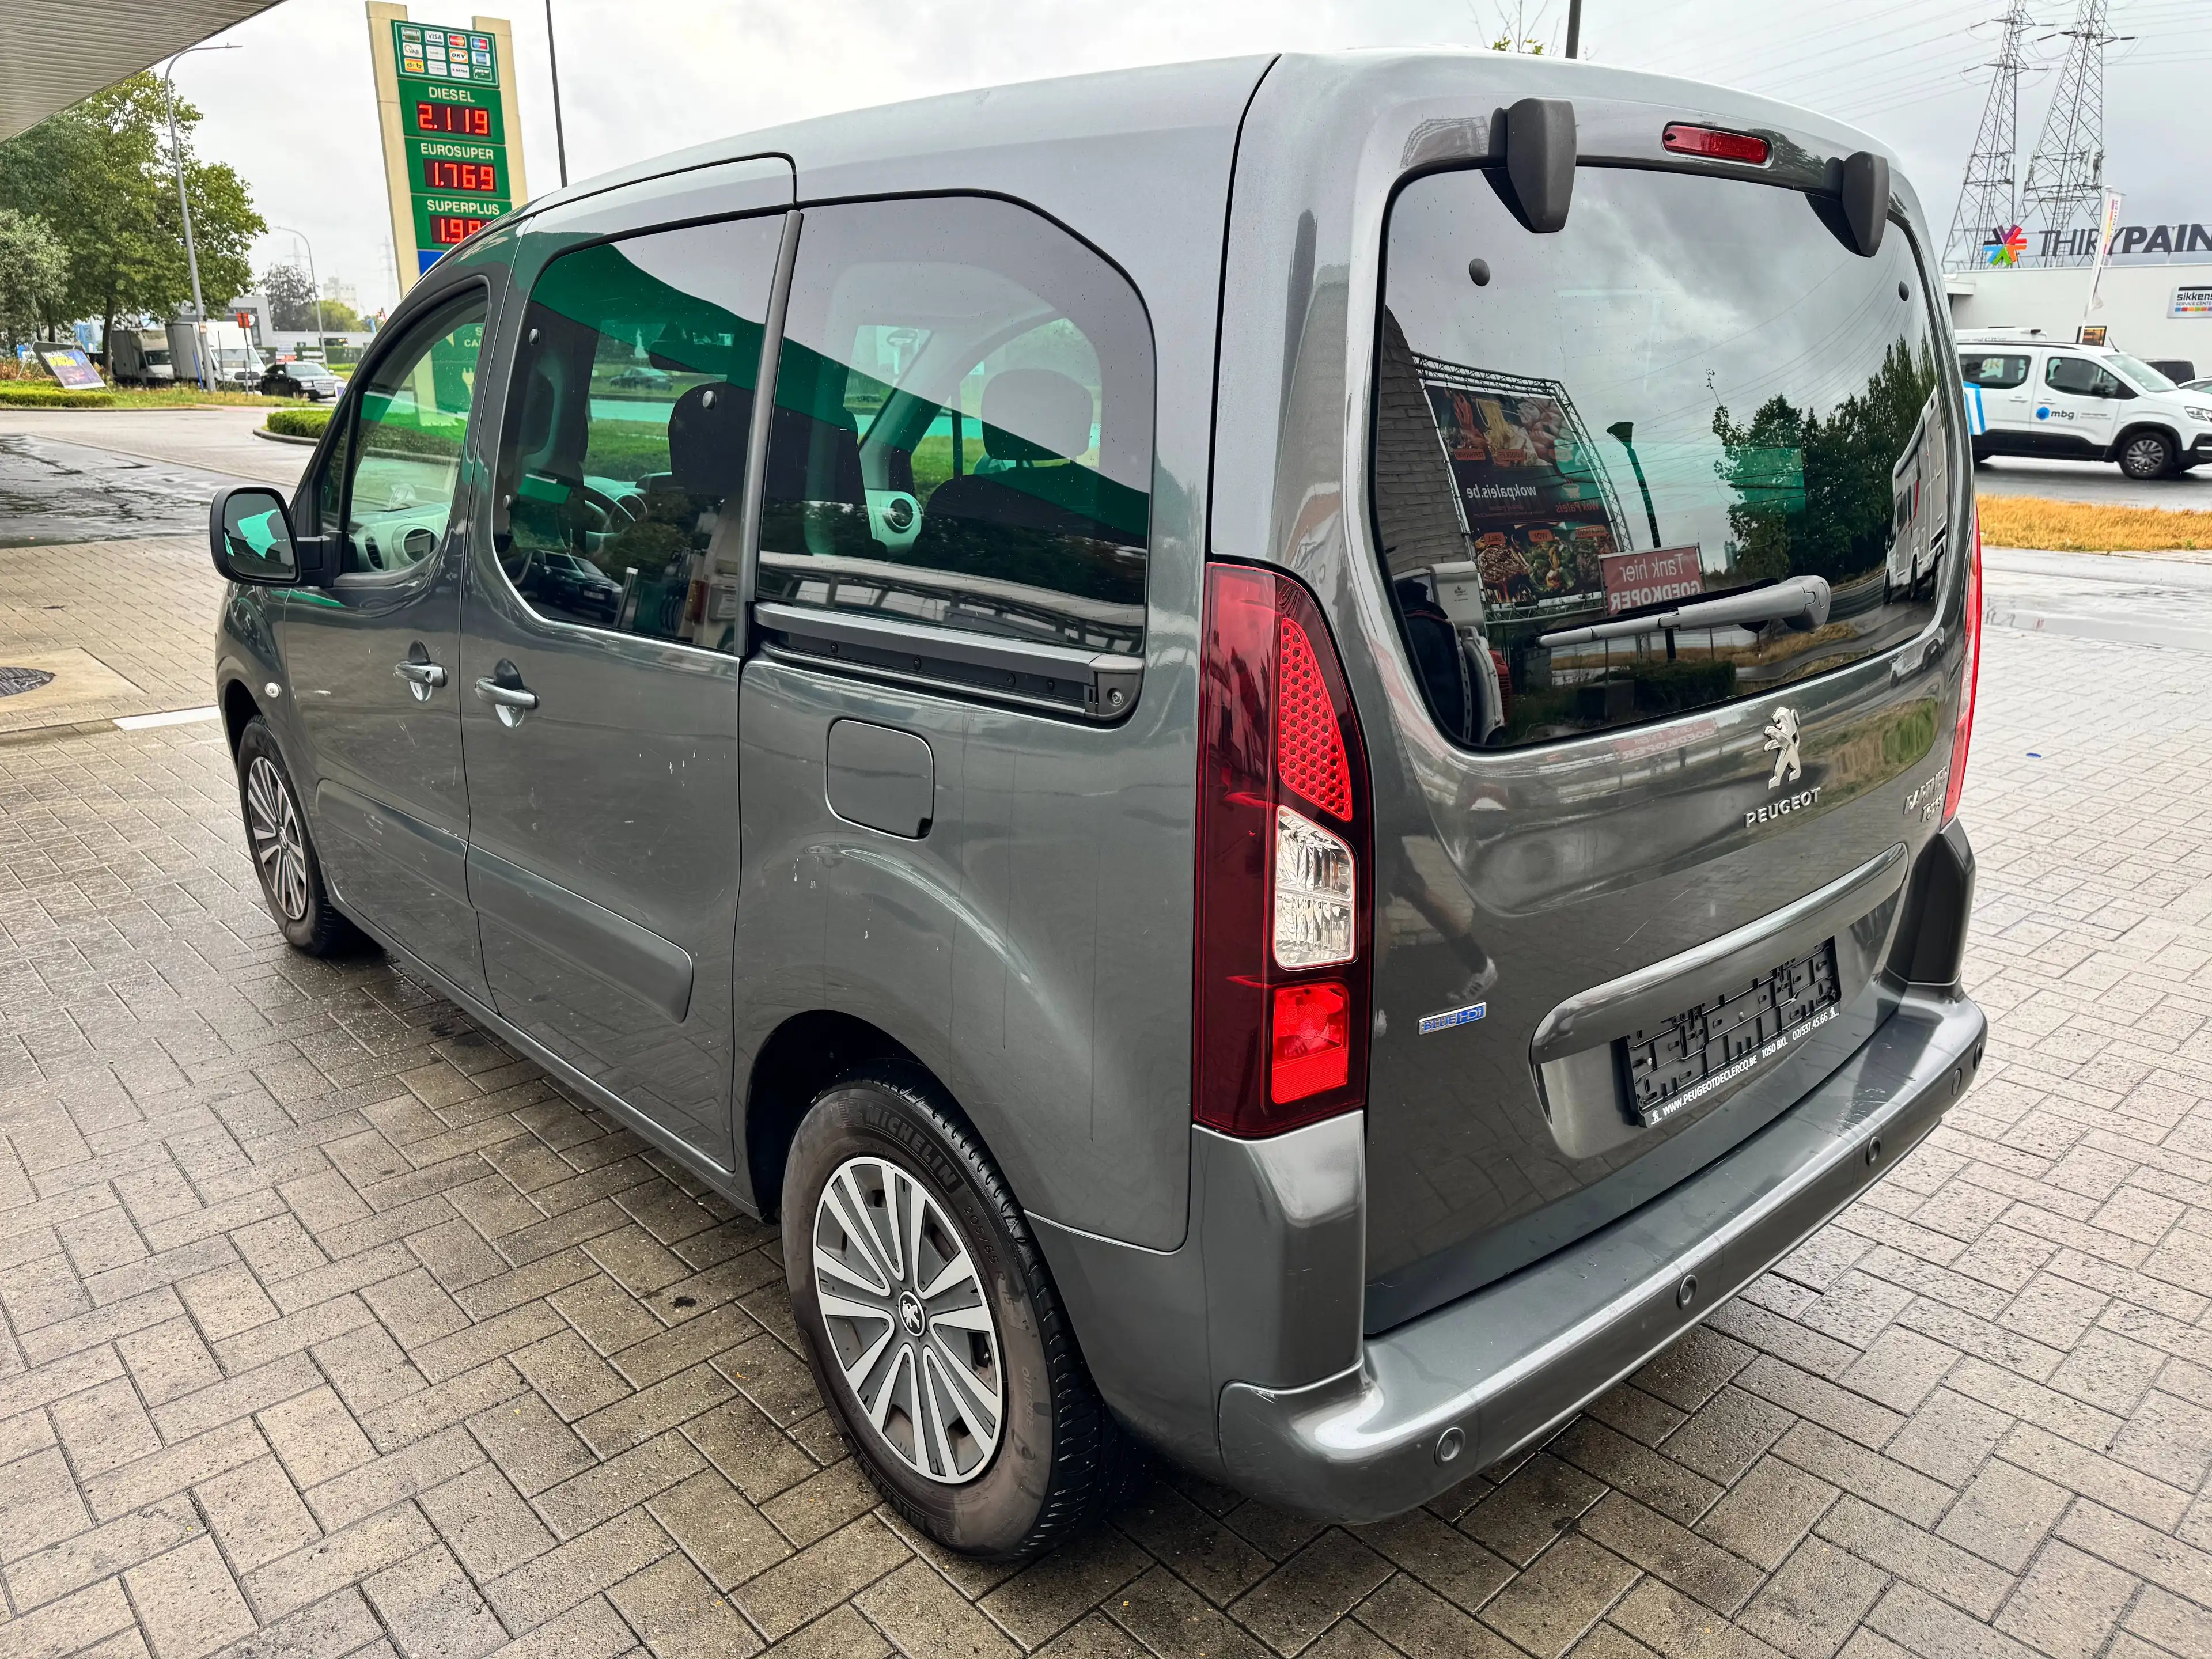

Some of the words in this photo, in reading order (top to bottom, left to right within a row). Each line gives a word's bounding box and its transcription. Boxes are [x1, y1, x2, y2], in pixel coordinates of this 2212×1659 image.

[428, 86, 475, 103] DIESEL
[419, 104, 488, 134] 2.119
[420, 143, 494, 160] EUROSUPER
[434, 162, 494, 190] 1.769
[427, 199, 500, 215] SUPERPLUS
[440, 218, 491, 243] 1.99
[2051, 410, 2074, 421] mbg
[1744, 787, 1821, 828] PEUGEOT
[1662, 1055, 1758, 1116] WWW.PEUGEOTDECLERCQ.BE
[1762, 1043, 1776, 1059] 1050
[1777, 1036, 1789, 1050] BXL
[1792, 1012, 1828, 1040] 02/537.45.66
[866, 1105, 957, 1187] MICHELIN
[963, 1206, 1000, 1264] 205/65
[1022, 1366, 1035, 1428] OUTSIDE
